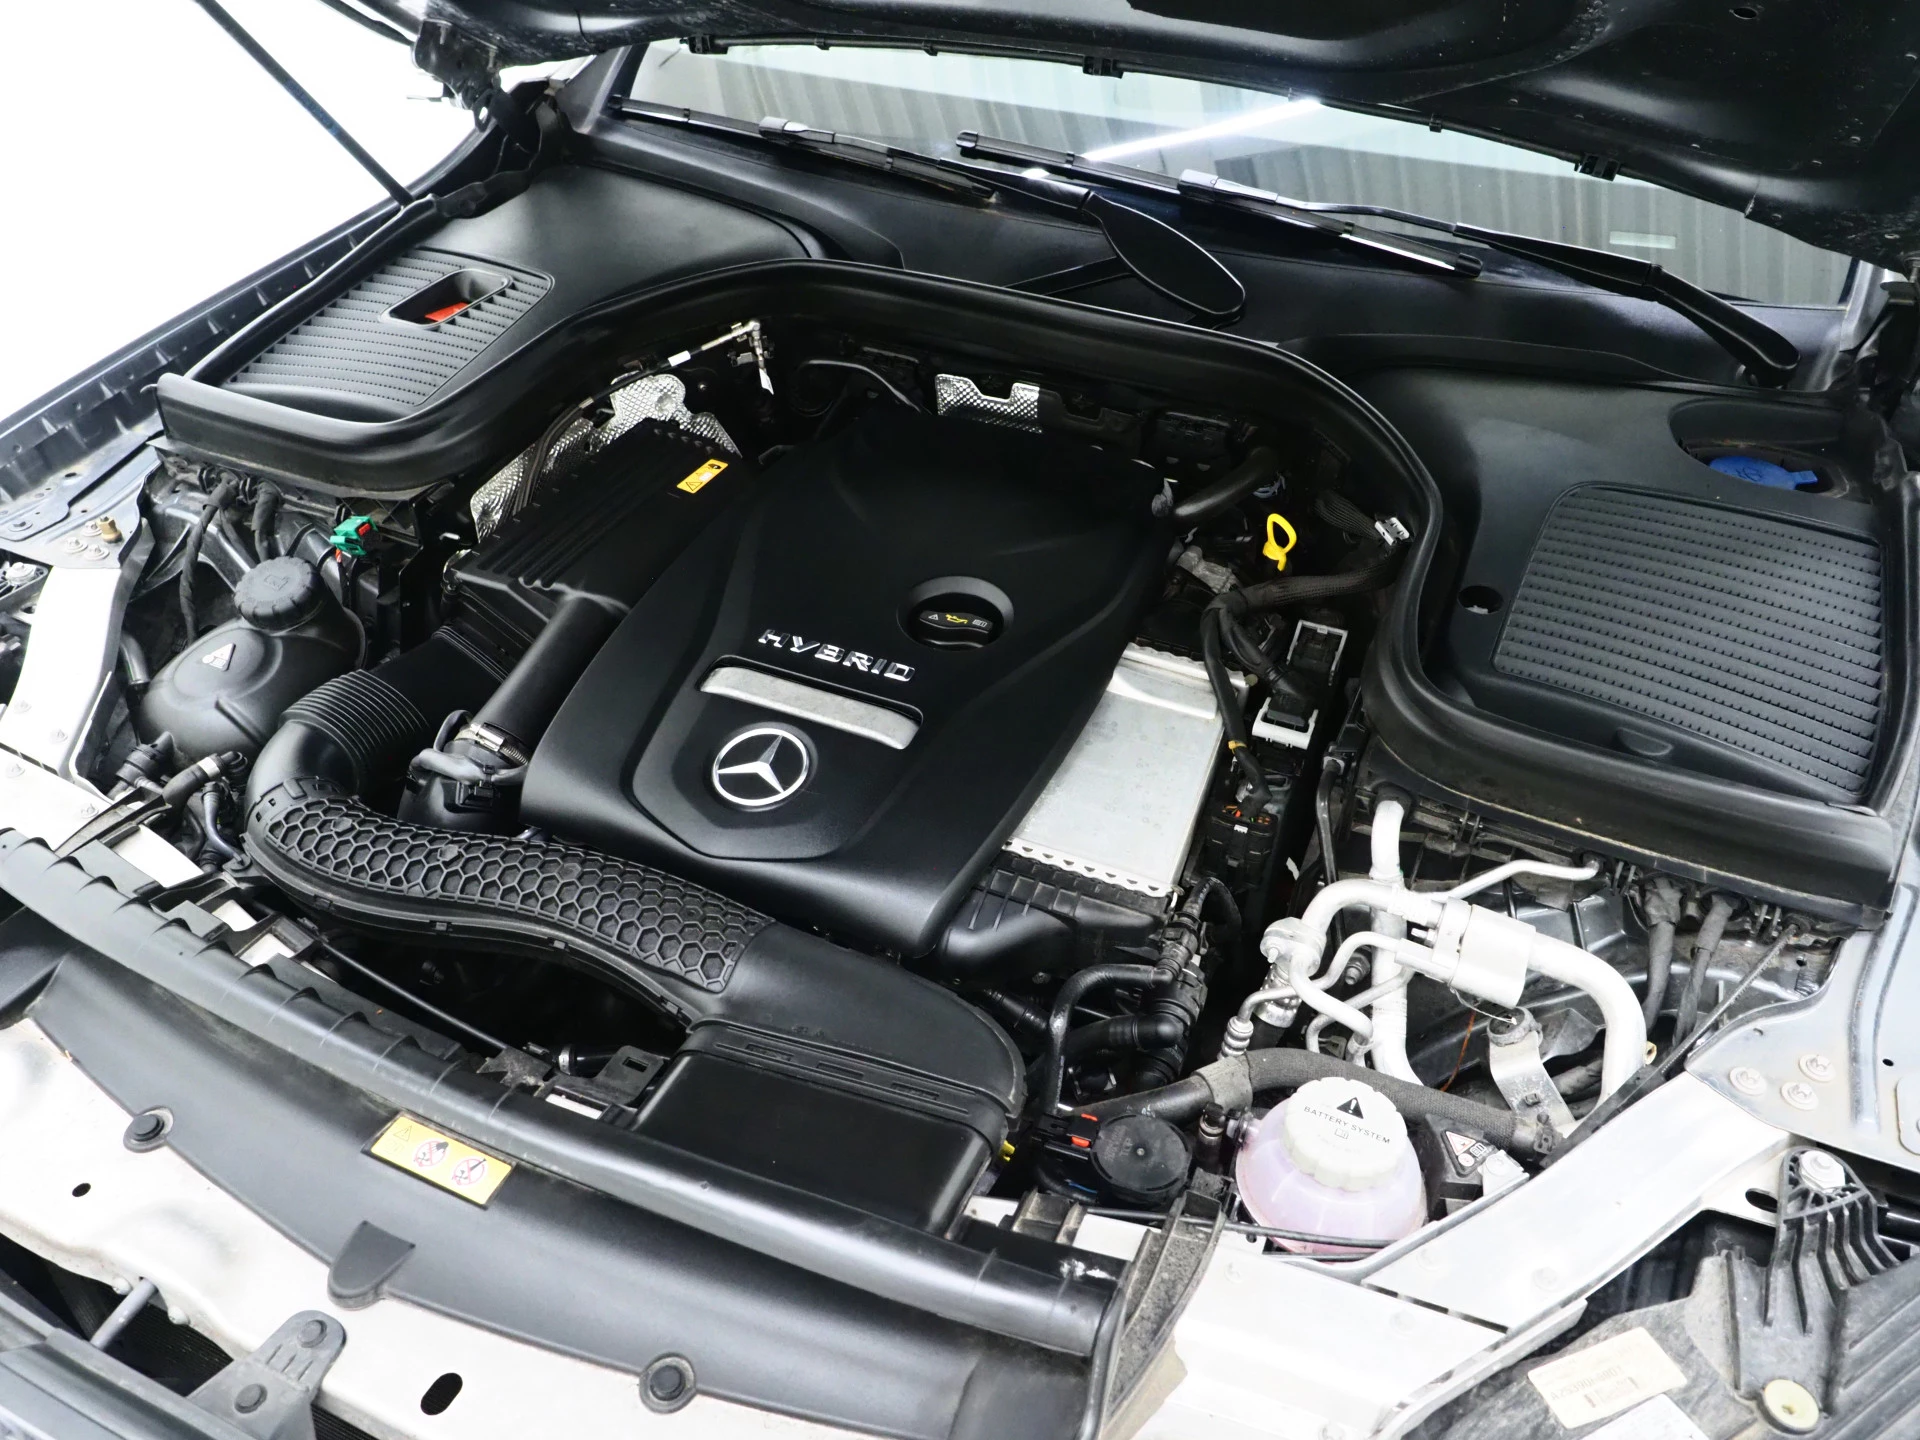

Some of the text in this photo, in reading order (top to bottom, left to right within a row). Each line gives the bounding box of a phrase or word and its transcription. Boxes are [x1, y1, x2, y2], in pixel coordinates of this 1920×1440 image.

[758, 629, 915, 682] HYBRID
[1303, 1106, 1347, 1126] BATTERY
[1351, 1124, 1390, 1144] SYSTEM
